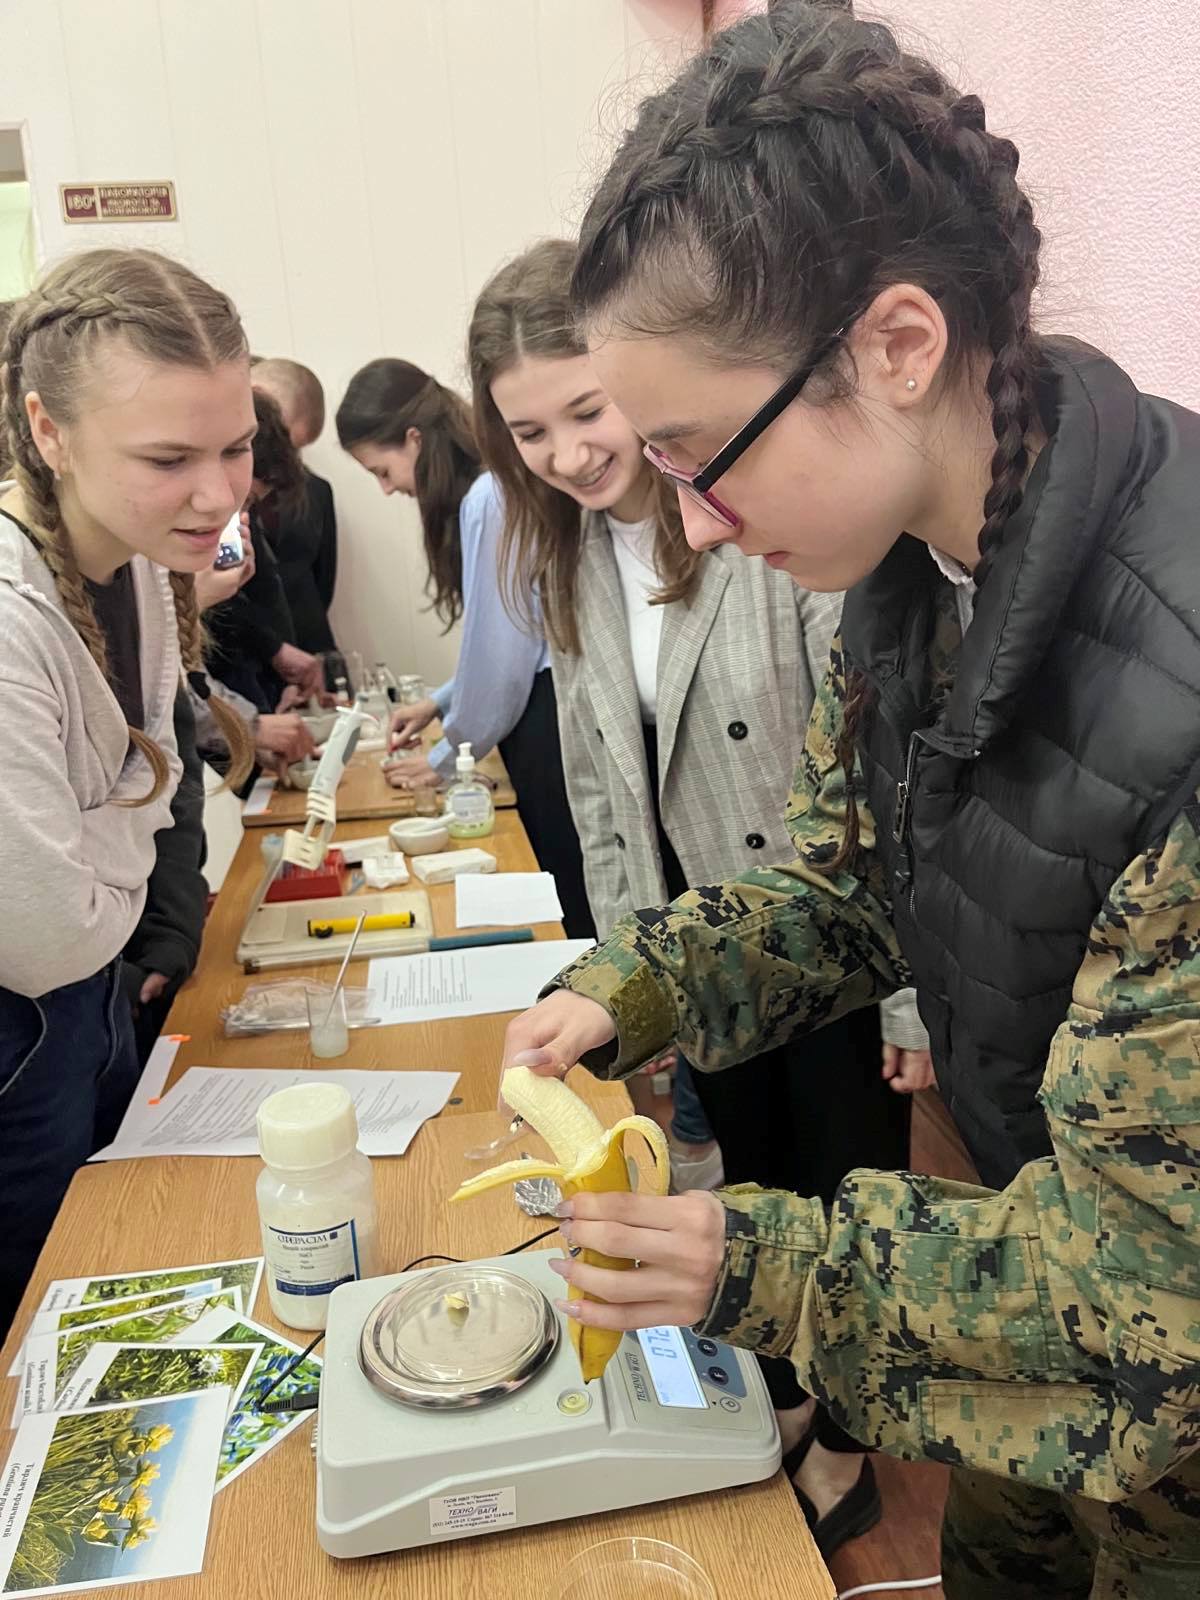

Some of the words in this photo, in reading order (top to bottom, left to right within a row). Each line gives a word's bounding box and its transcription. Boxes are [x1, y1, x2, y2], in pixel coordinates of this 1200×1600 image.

[3, 1462, 21, 1496] (Gentiana
[18, 1462, 35, 1491] Тирлич
[2, 1493, 23, 1538] крапчастий
